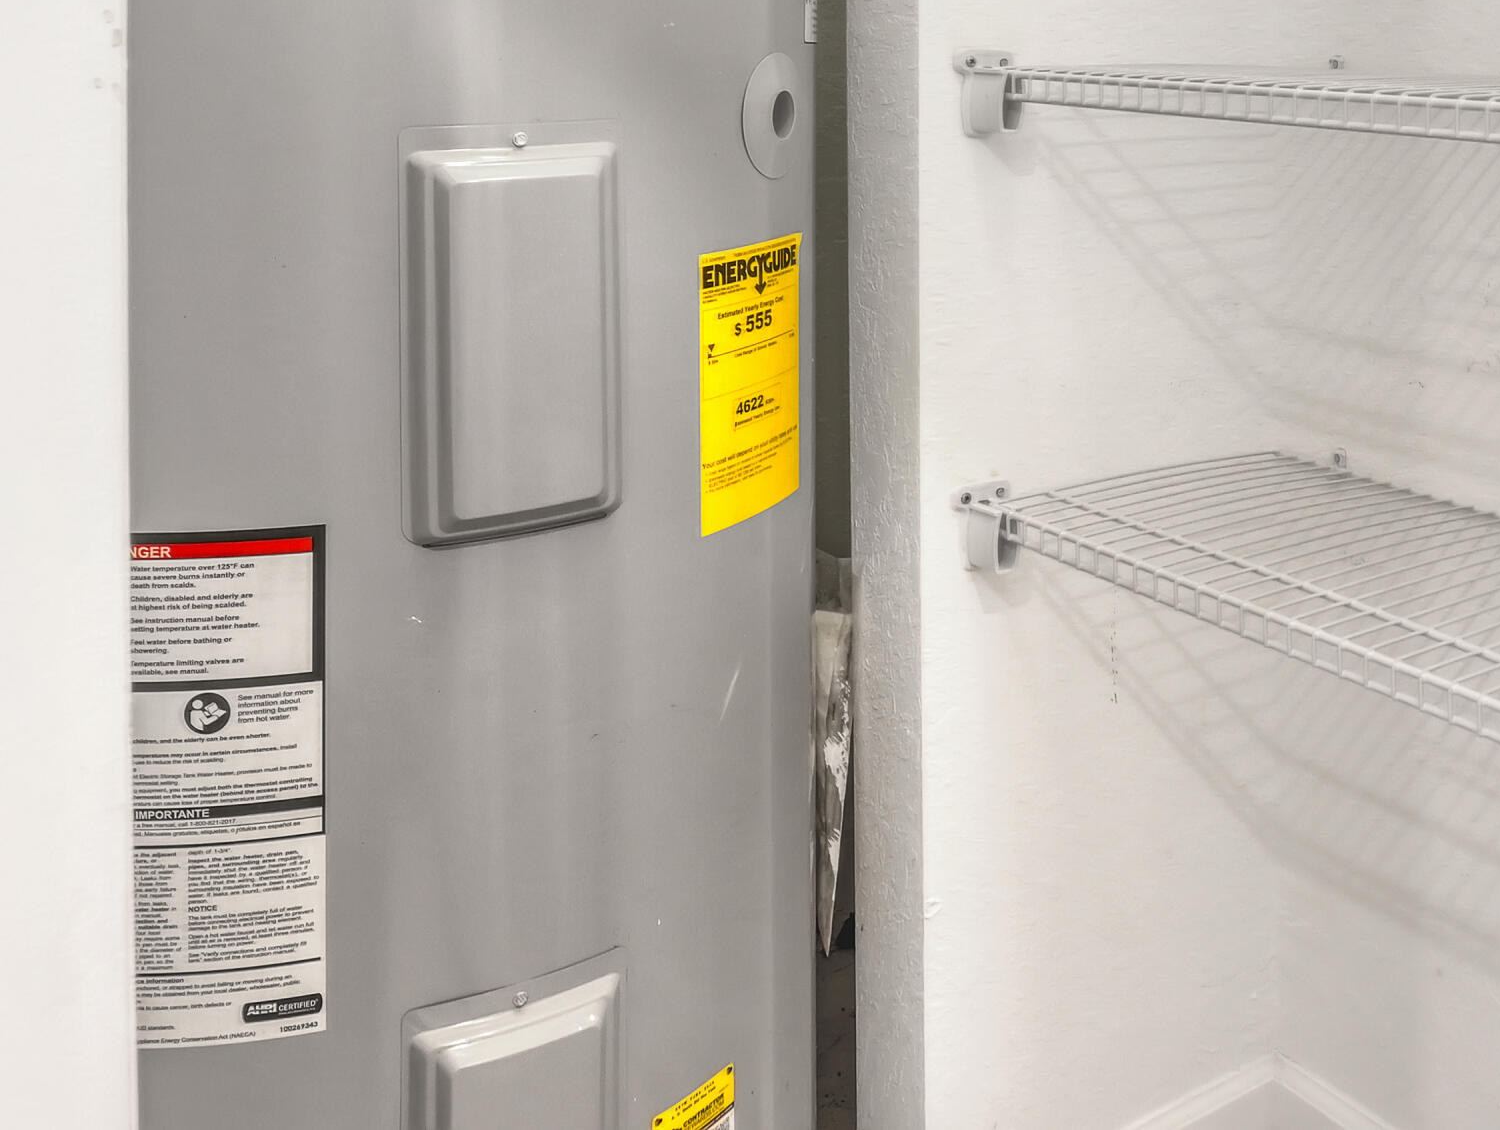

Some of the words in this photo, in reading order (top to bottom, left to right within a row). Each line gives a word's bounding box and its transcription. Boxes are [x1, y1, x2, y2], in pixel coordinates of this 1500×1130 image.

[702, 244, 796, 290] ENERGYGUIDE
[718, 308, 744, 320] Estimated
[744, 304, 760, 313] Yearly
[760, 300, 775, 310] Energy
[734, 322, 742, 336] $
[746, 308, 772, 333] 555
[736, 394, 764, 415] 4622
[202, 572, 235, 580] instantly
[130, 595, 162, 603] Children,
[213, 593, 239, 601] elderly
[138, 604, 165, 612] highest
[192, 602, 213, 610] being
[156, 625, 200, 633] temperature
[193, 637, 222, 645] bathing
[176, 659, 203, 667] limiting
[238, 699, 278, 707] information
[238, 707, 276, 716] preventing
[135, 808, 210, 820] IMPORTANTE
[683, 1093, 724, 1127] CONTRACTOR
